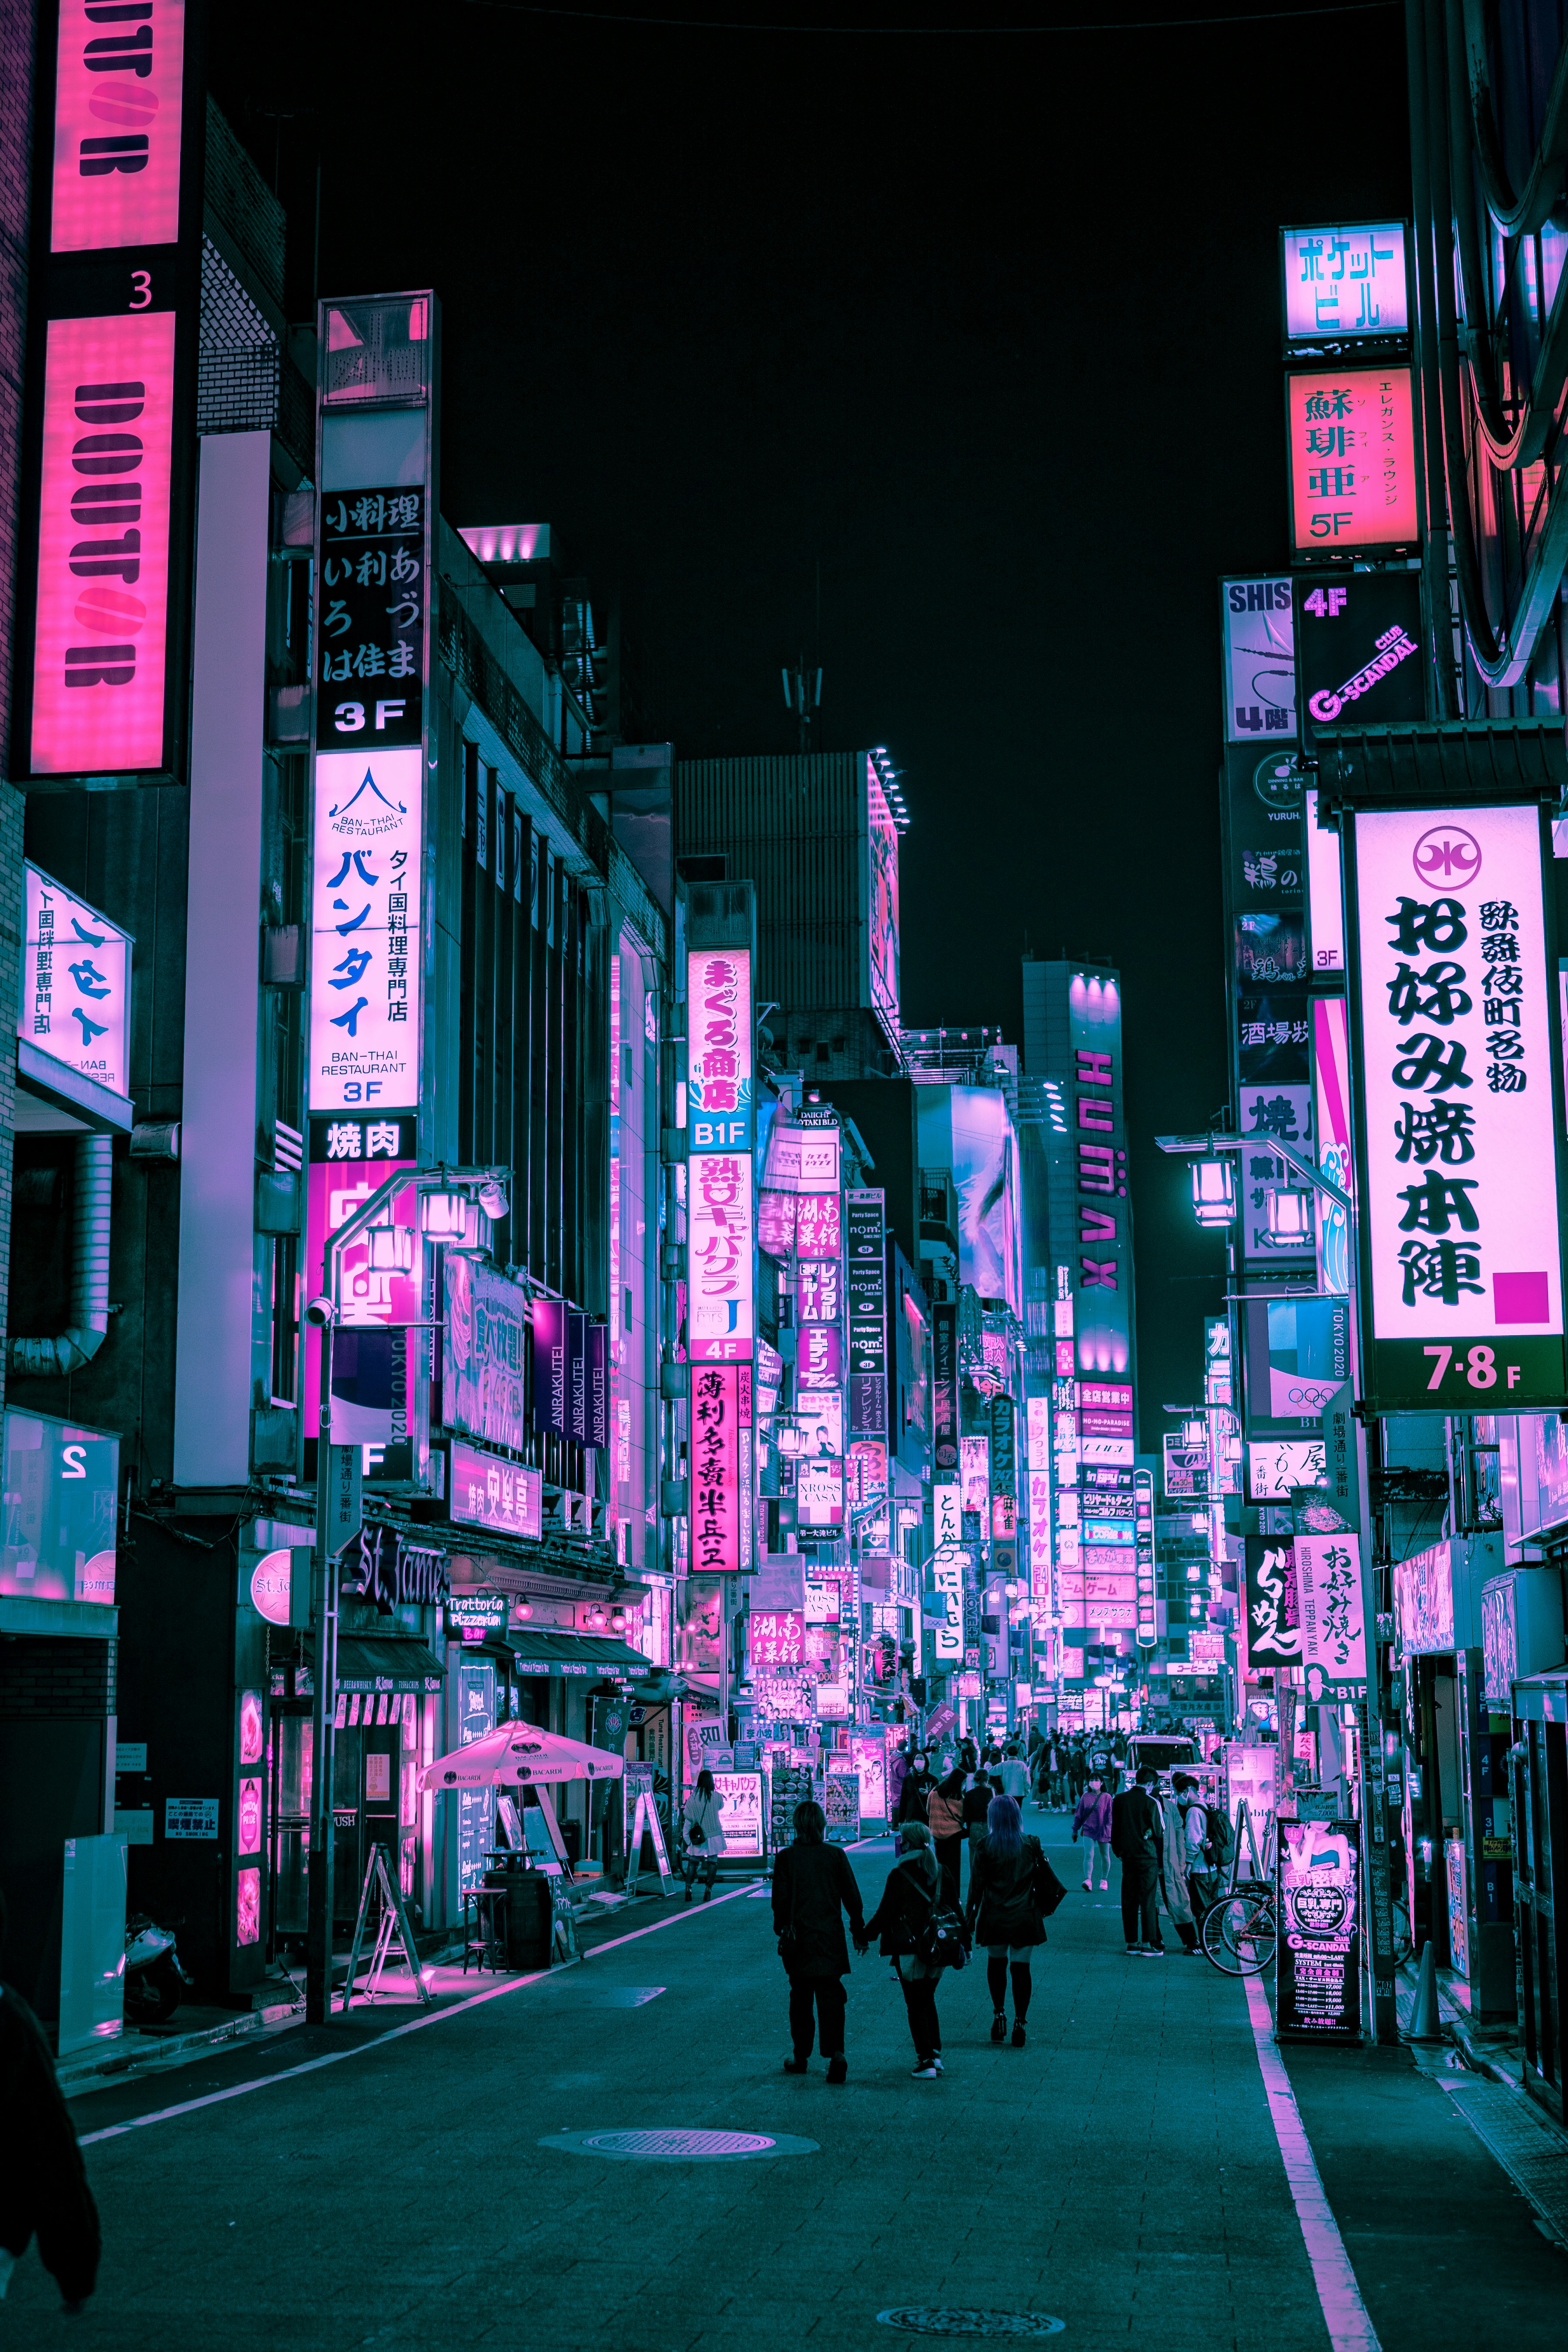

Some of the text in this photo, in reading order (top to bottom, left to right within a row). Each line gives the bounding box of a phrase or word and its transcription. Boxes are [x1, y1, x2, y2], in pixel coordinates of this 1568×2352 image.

[1300, 235, 1394, 281] ポケット
[129, 271, 152, 308] 3
[1316, 283, 1380, 329] ビル
[326, 493, 419, 533] 小料理
[1309, 512, 1353, 538] 5F
[65, 382, 147, 688] DOUTOR
[386, 545, 419, 678] あづま
[1229, 583, 1292, 613] SHIS
[1304, 587, 1347, 617] 4F
[323, 556, 353, 683] いろは
[1375, 625, 1403, 650] CLUB
[1309, 638, 1418, 721] G-SCANDAL
[334, 700, 406, 732] 3F
[1236, 707, 1288, 731] 4階
[332, 818, 404, 836] RESTAURANT
[341, 814, 395, 825] BAN-THAI
[387, 850, 408, 1022] タイ国料理専門店
[1242, 921, 1255, 931] 2F
[326, 850, 379, 1037] バンタイ
[1317, 950, 1338, 966] 3F
[1479, 901, 1527, 1093] 歌舞伎町名物
[703, 960, 737, 1111] まぐろ商店
[322, 1063, 407, 1075] RESTAURANT
[332, 1050, 397, 1062] BAN-THAI
[343, 1082, 383, 1102] 3F
[1384, 896, 1486, 1307] お好み焼本陣
[327, 1121, 400, 1159] 焼肉
[694, 1122, 745, 1145] B1F
[694, 1157, 749, 1297] 熟女キャバクラ
[811, 1247, 826, 1256] 4F
[801, 1264, 818, 1275] 3F
[802, 1278, 819, 1320] ルーム
[821, 1263, 837, 1320] レンタル
[711, 1299, 747, 1335] J
[706, 1341, 737, 1359] 4F
[809, 1329, 828, 1372] エデン
[1332, 1307, 1345, 1377] TOKYO 2020
[552, 1347, 562, 1427] ANRAKUTEI
[573, 1357, 584, 1436] ANRAKUTEI
[739, 1371, 751, 1420] 炭火串焼
[806, 1374, 839, 1388] Eden
[1082, 1389, 1130, 1405] 全店営業中
[594, 1368, 603, 1444] ANRAKUTEI
[861, 1377, 872, 1431] リフレッシュ
[392, 1397, 407, 1446] 2020
[994, 1400, 1012, 1470] カラオケ
[1333, 1412, 1349, 1498] 劇場通り一番街
[339, 1444, 353, 1523] 劇場通り一番街
[800, 1484, 841, 1493] XROSS
[994, 1469, 1012, 1481] 747
[1255, 1457, 1269, 1497] 一番街
[468, 1482, 484, 1516] 焼肉
[487, 1464, 528, 1528] 安楽亭
[804, 1493, 837, 1502] CASA
[1003, 1497, 1014, 1530] 麻雀
[1032, 1476, 1048, 1558] カラオケ
[741, 1508, 751, 1556] 楽しいお店
[1300, 1547, 1313, 1594] HIROSHIMA
[449, 1596, 503, 1611] Trattoria
[1087, 1582, 1117, 1595] ゲーム
[1320, 1545, 1362, 1665] お好み焼き
[452, 1612, 501, 1626] Pizzeria
[463, 1627, 488, 1640] Bar
[343, 1680, 372, 1689] BEER&WHISKY
[399, 1680, 419, 1689] FISH&CHIPS
[1337, 1685, 1367, 1700] B1F
[168, 1818, 216, 1830] 喫煙禁止
[241, 1801, 258, 1817] LONDON
[243, 1814, 256, 1826] PRIDE
[1288, 1829, 1299, 1838] 4F
[1297, 1897, 1342, 1911] 巨乳専門
[1287, 1933, 1350, 1952] G-SCANDAL
